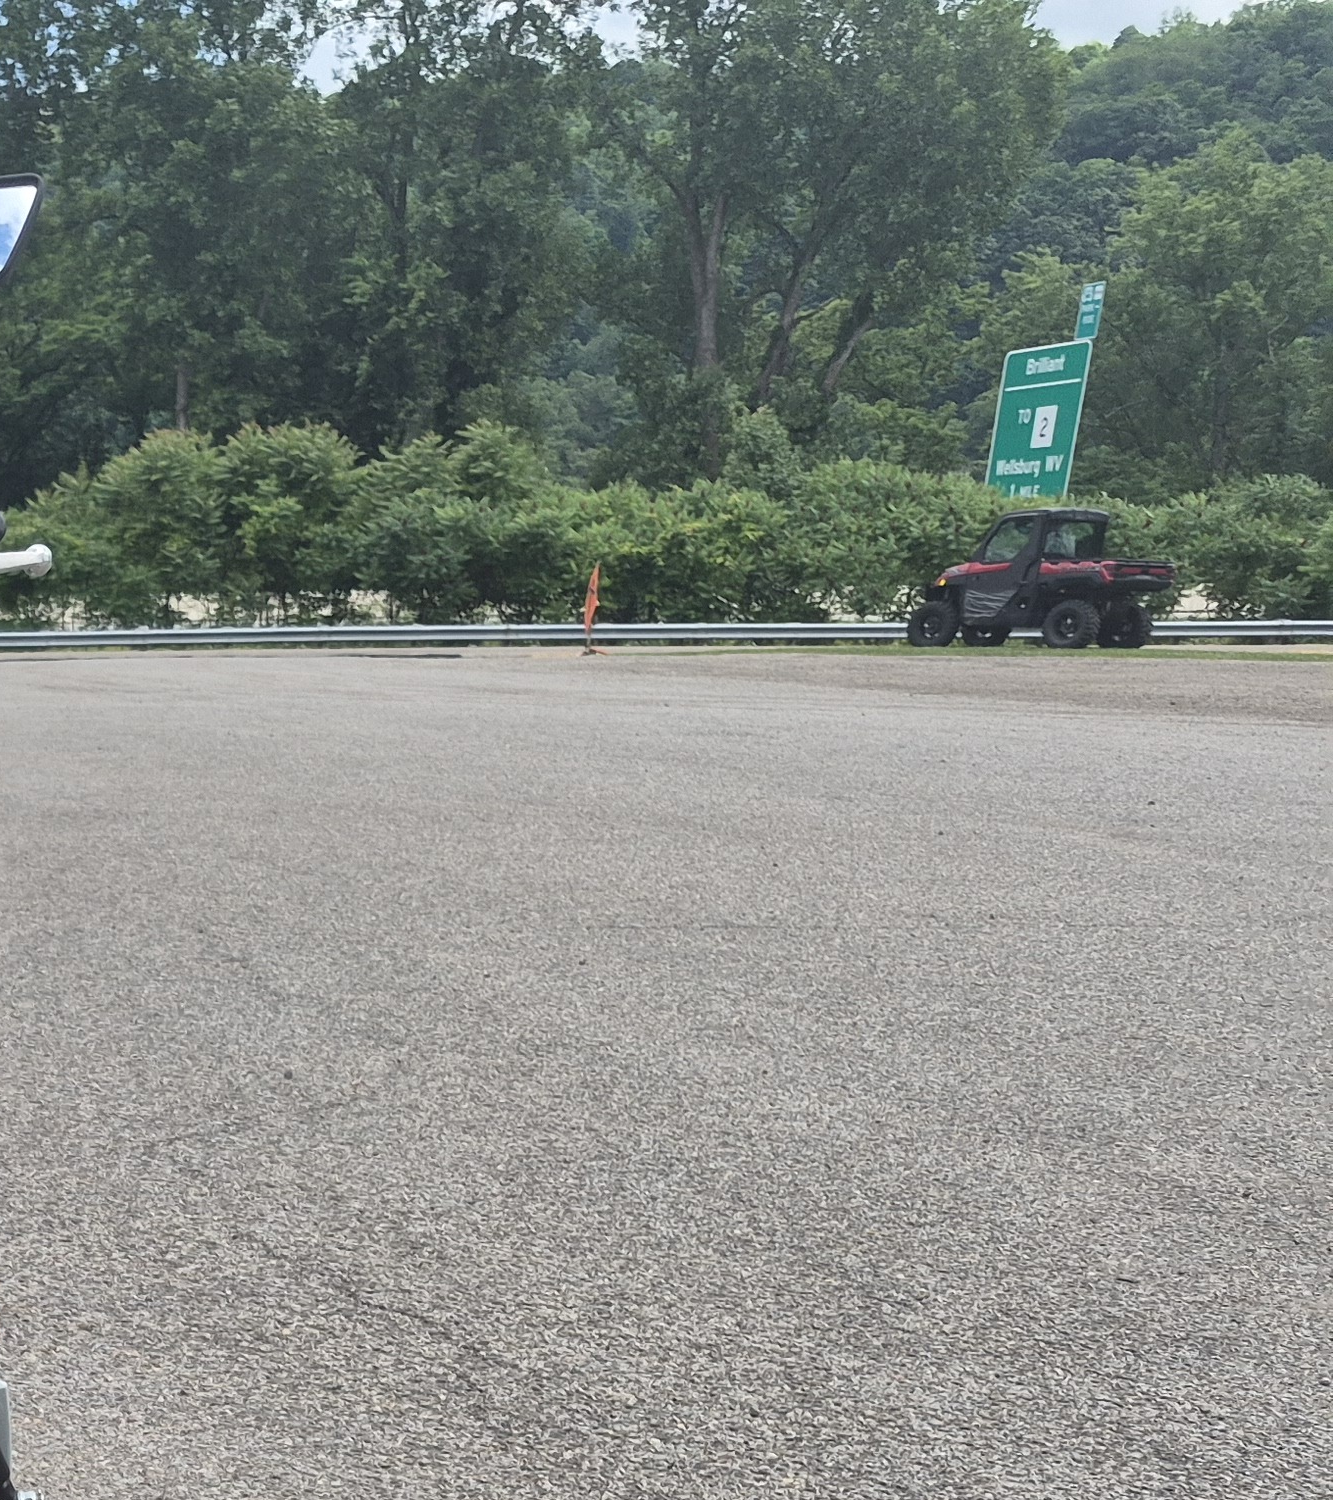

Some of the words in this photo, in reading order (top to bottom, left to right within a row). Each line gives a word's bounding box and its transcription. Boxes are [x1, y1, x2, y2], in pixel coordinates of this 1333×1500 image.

[1026, 354, 1066, 375] Brilliant
[1018, 408, 1032, 424] TO
[1039, 416, 1049, 437] 2
[996, 458, 1041, 478] Wellsburg
[1045, 454, 1064, 472] WV
